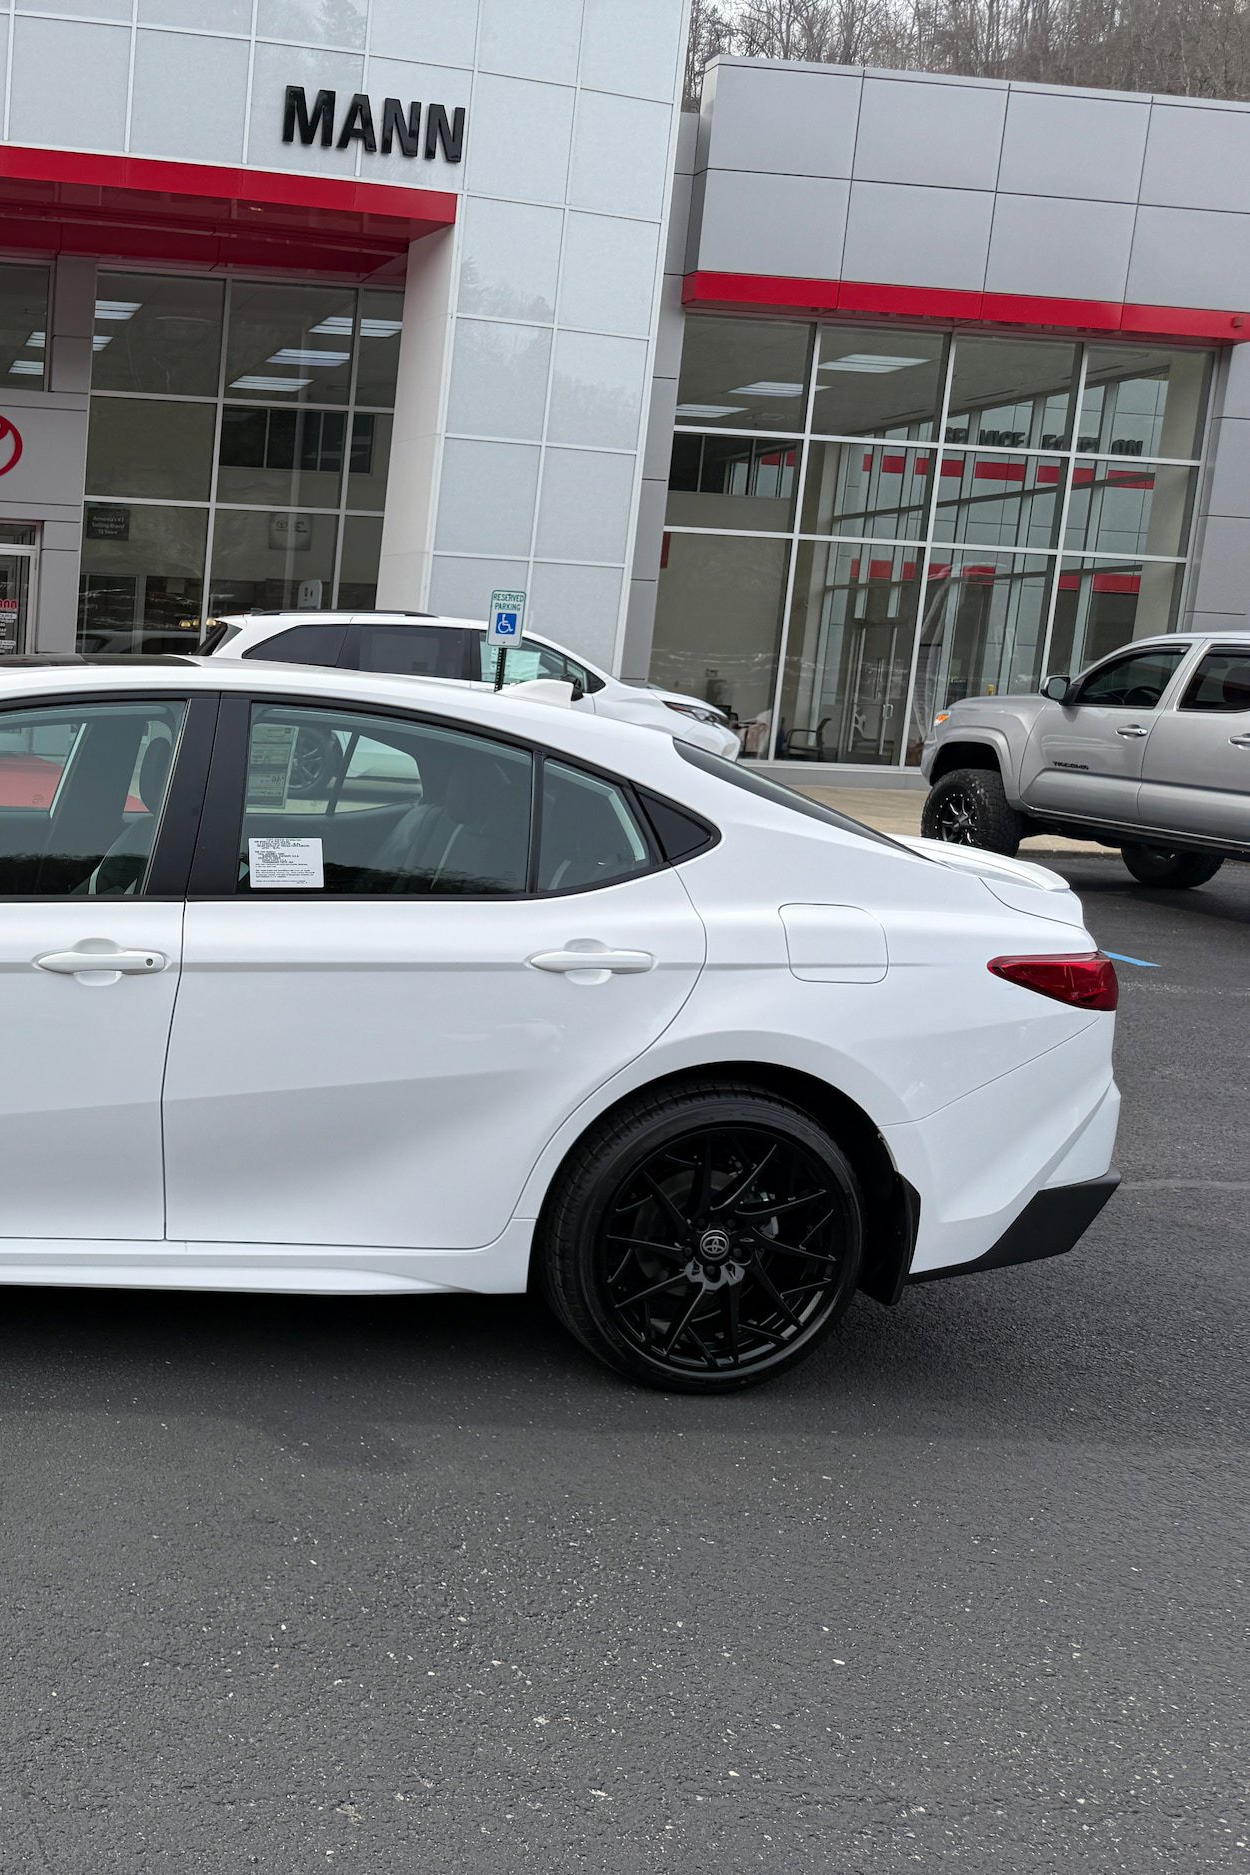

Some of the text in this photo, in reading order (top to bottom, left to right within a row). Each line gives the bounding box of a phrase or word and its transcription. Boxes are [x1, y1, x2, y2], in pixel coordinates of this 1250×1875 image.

[283, 85, 466, 163] MANN
[493, 593, 525, 603] RESERVED
[494, 602, 521, 611] PARKING
